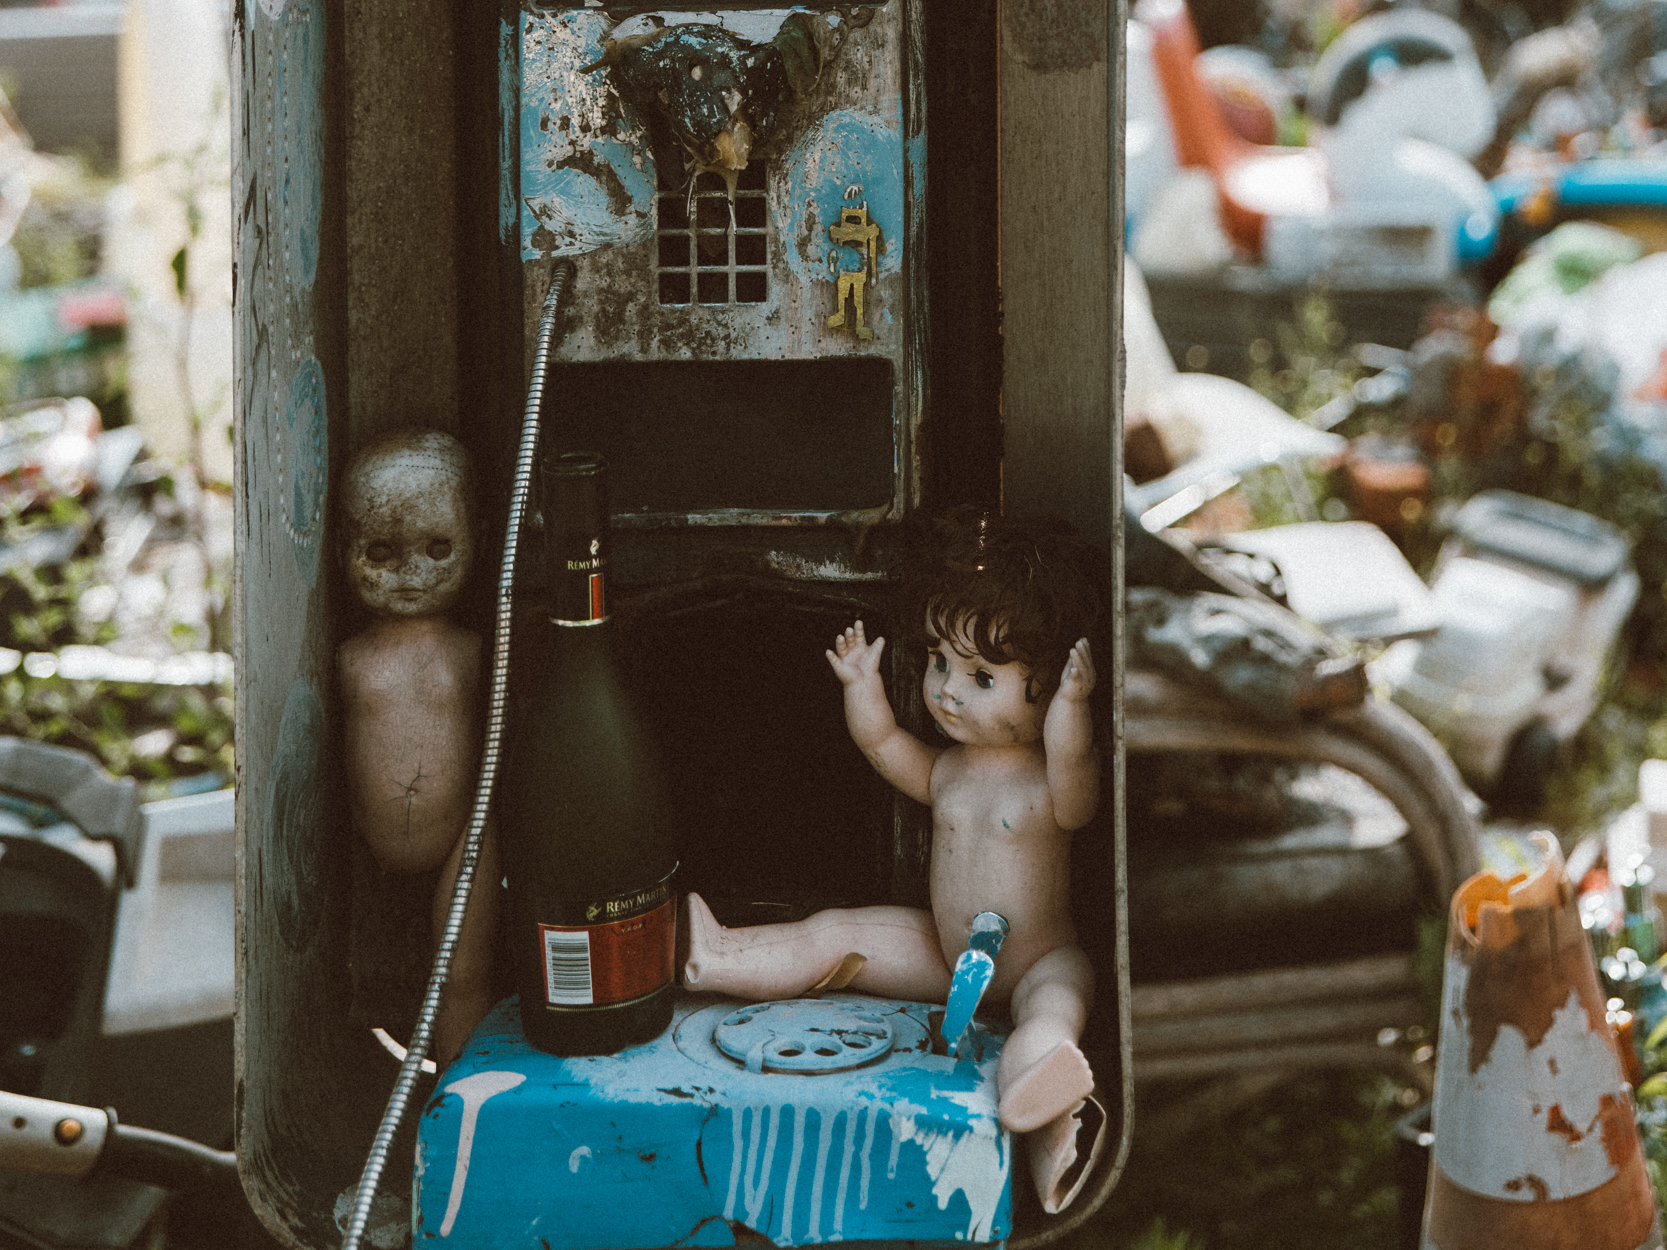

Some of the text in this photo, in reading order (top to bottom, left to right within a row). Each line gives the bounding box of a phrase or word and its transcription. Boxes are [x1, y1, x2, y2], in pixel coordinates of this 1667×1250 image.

[567, 559, 591, 570] RÉMY
[606, 898, 635, 914] RÉMY
[636, 885, 667, 907] MARTIN
